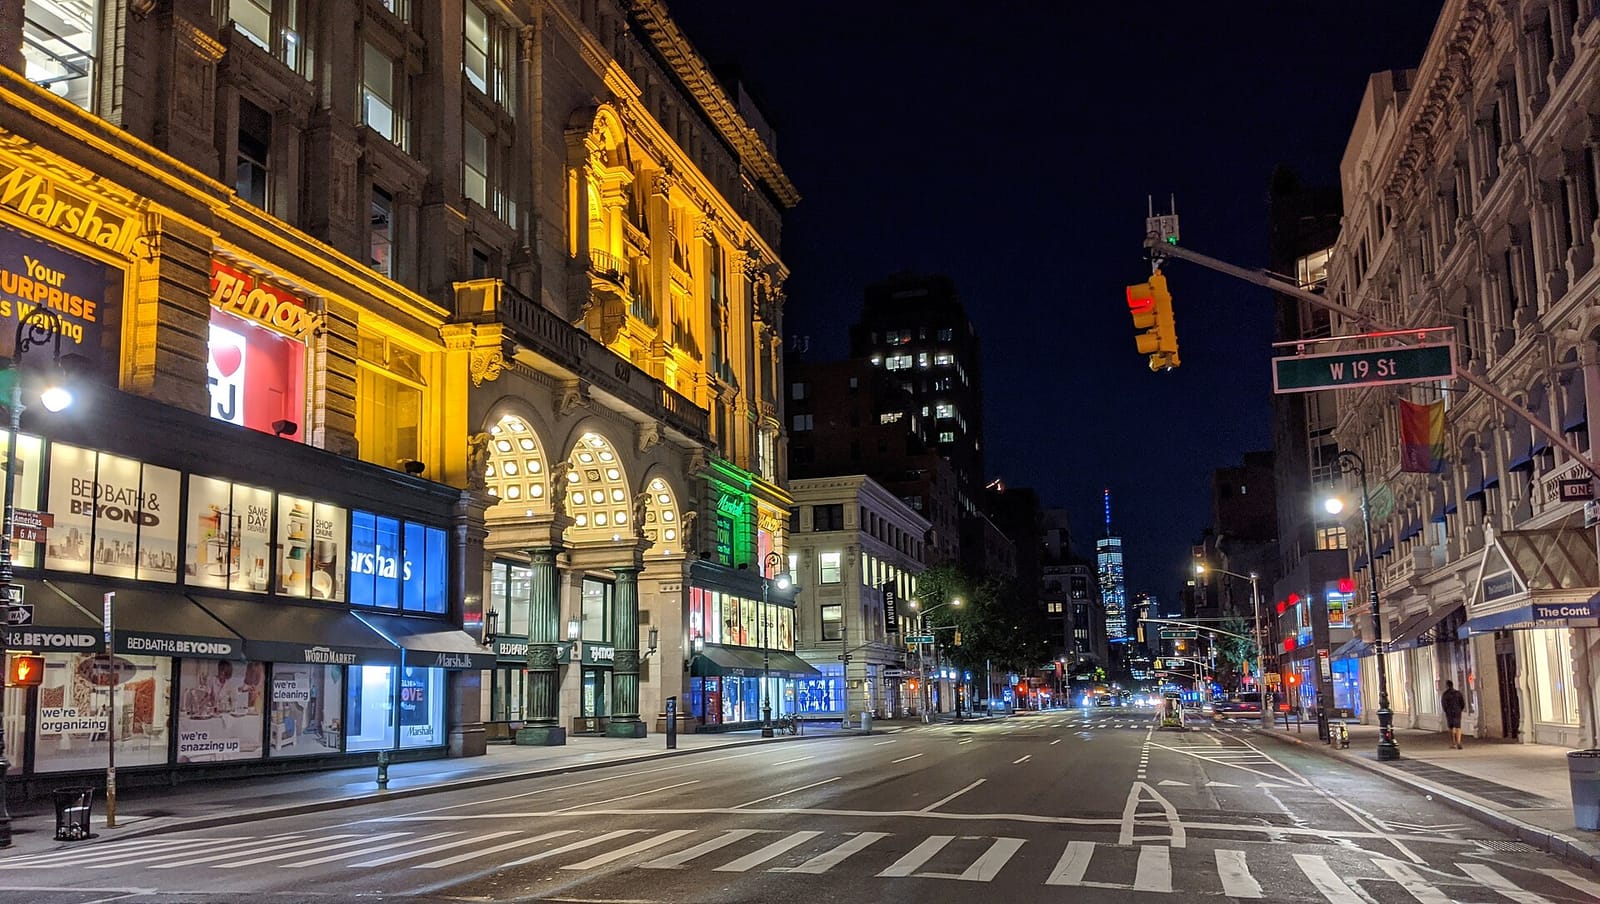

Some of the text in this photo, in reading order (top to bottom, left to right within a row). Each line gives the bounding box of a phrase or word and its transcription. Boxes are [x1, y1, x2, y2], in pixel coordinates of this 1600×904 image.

[0, 166, 150, 258] Marshalls
[24, 255, 66, 287] Your
[0, 269, 96, 322] URPRISE
[0, 297, 12, 317] s
[1330, 360, 1397, 381] W 19 St
[72, 478, 160, 511] BED BATH &
[1570, 482, 1592, 495] ONE
[70, 499, 160, 526] BEYOND
[248, 505, 268, 517] SAME
[14, 515, 42, 526] Americas
[248, 515, 267, 527] DAY
[316, 520, 333, 530] SHOP
[20, 528, 37, 540] 6 Av
[316, 529, 333, 538] ONLINE
[886, 592, 894, 605] OLD
[12, 611, 25, 619] WAY
[1537, 608, 1559, 617] The
[24, 633, 96, 646] BEYOND
[127, 637, 232, 654] BED BATH & BEYOND
[304, 650, 356, 664] WORLD MARKET
[435, 653, 472, 668] Marshalls
[274, 680, 296, 689] we're
[274, 689, 309, 700] cleaning
[42, 708, 76, 717] we're
[41, 718, 107, 732] organizing
[181, 732, 208, 740] we're
[180, 741, 239, 752] snazzing up
